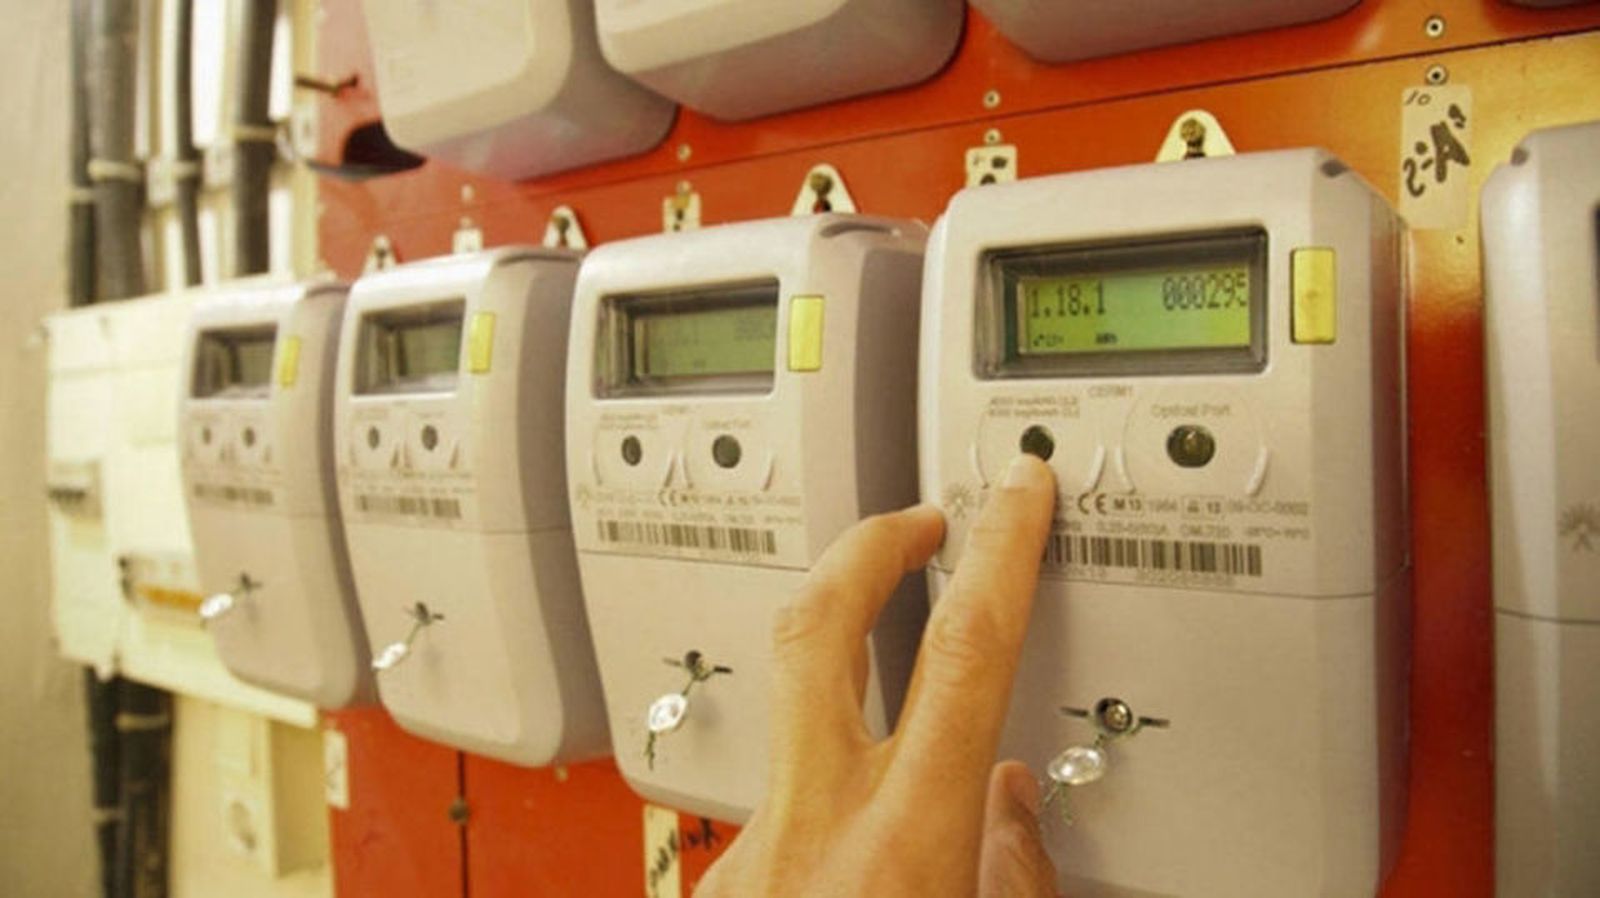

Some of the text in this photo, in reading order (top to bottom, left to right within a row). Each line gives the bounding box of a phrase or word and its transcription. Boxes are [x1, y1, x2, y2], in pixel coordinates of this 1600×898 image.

[1030, 280, 1106, 318] 1.18.1
[1201, 402, 1231, 417] Port
[1078, 492, 1107, 515] CE
